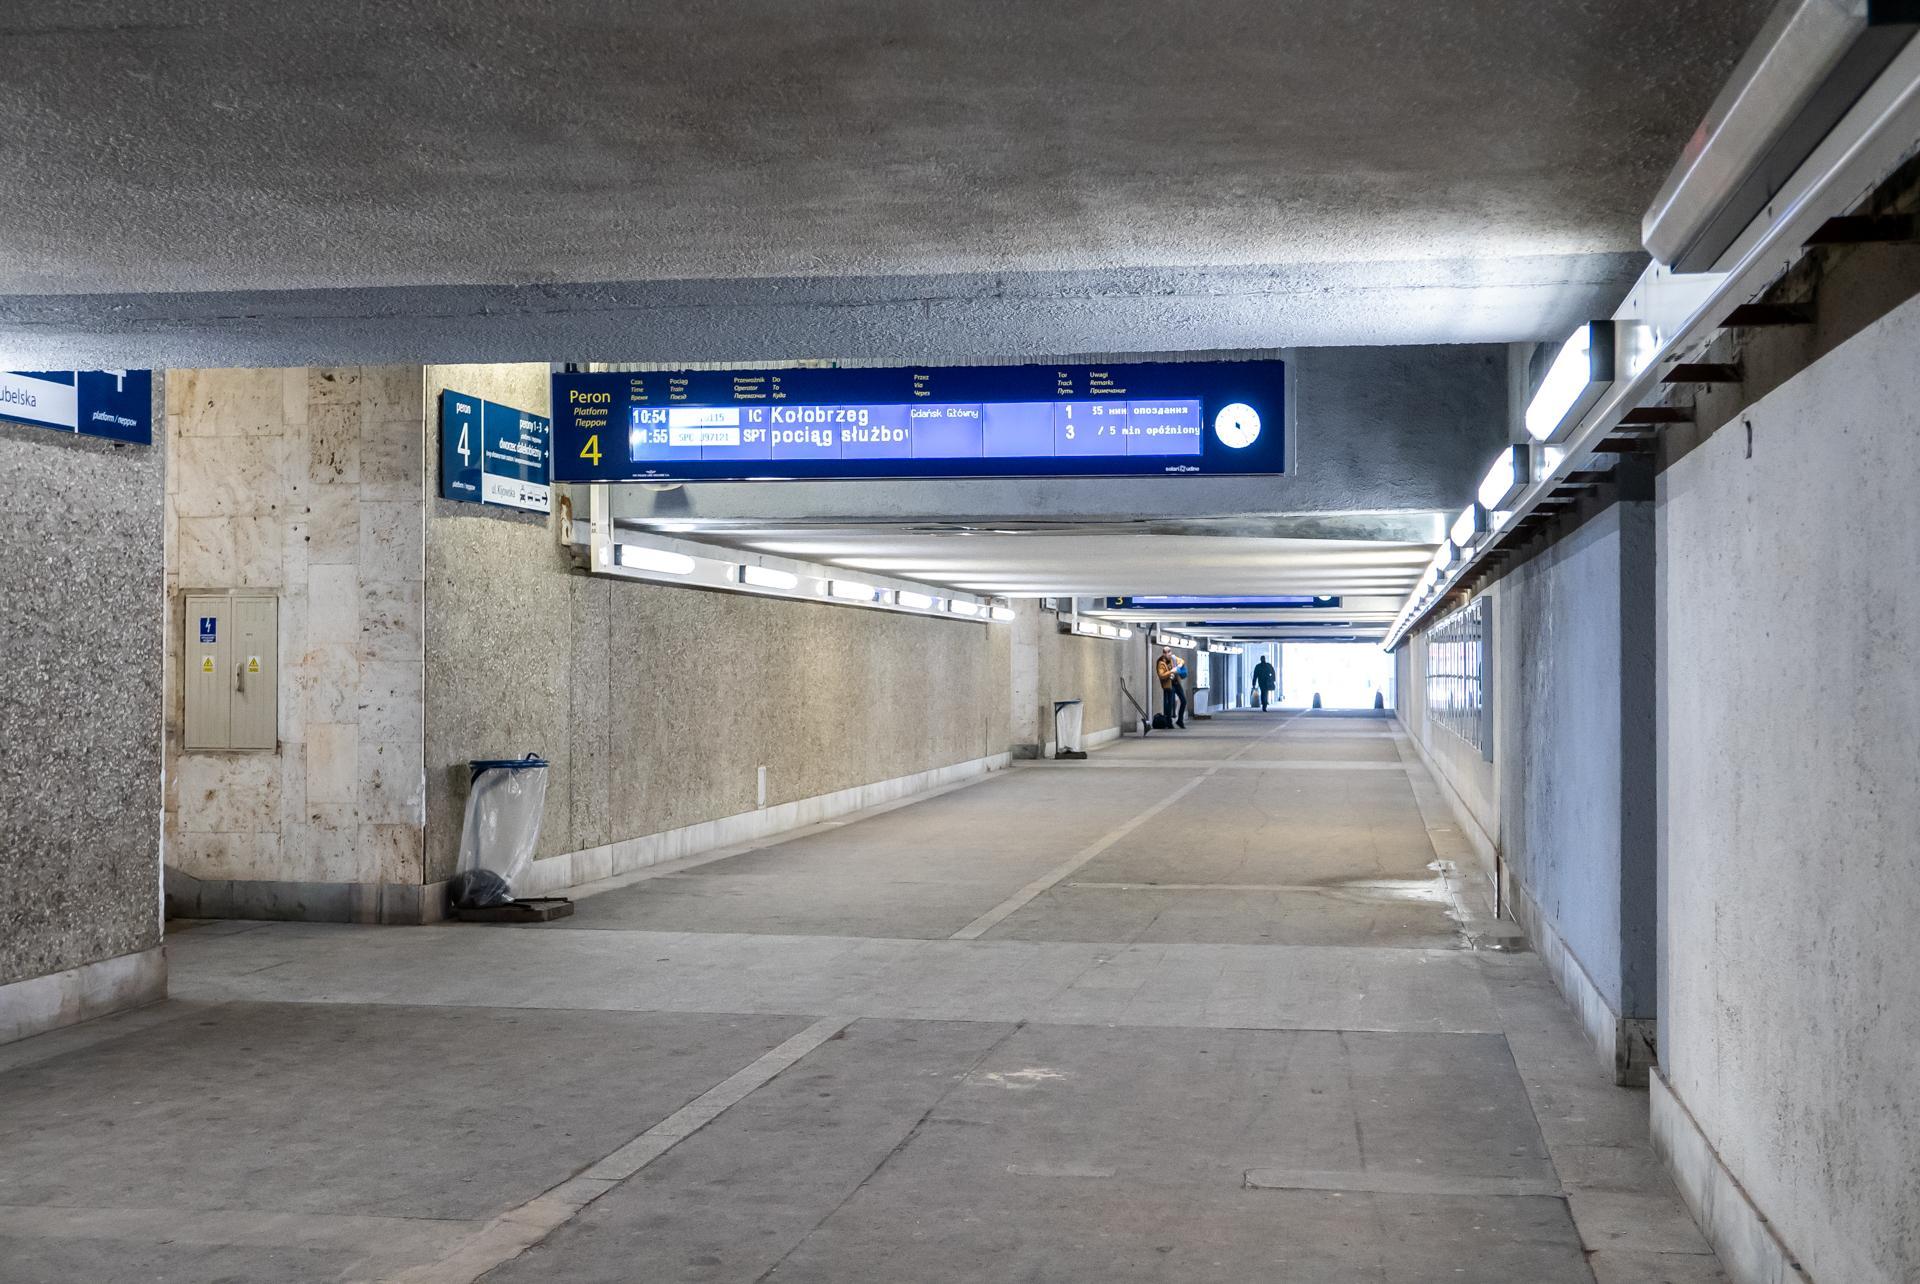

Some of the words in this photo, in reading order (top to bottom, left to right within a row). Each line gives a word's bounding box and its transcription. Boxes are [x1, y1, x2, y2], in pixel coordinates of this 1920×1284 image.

[569, 390, 611, 404] Peron
[456, 402, 471, 415] peron
[574, 407, 608, 416] Platform
[1133, 406, 1189, 415] опоздания
[92, 410, 115, 422] platform
[632, 409, 667, 424] 10:54
[748, 409, 762, 422] IC
[771, 406, 869, 426] Kołobrzeg
[910, 408, 943, 418] Gdańsk
[946, 408, 979, 419] Główny
[1065, 405, 1072, 419] 1
[575, 418, 607, 429] Перрон
[743, 428, 767, 442] SPT
[771, 426, 833, 447] pociąg
[1065, 424, 1075, 439] 3
[1097, 426, 1104, 436] /
[1109, 426, 1116, 435] 5
[1122, 425, 1141, 435] min
[1146, 425, 1200, 437] opóźniony
[457, 422, 471, 467] 4
[579, 434, 602, 466] 4
